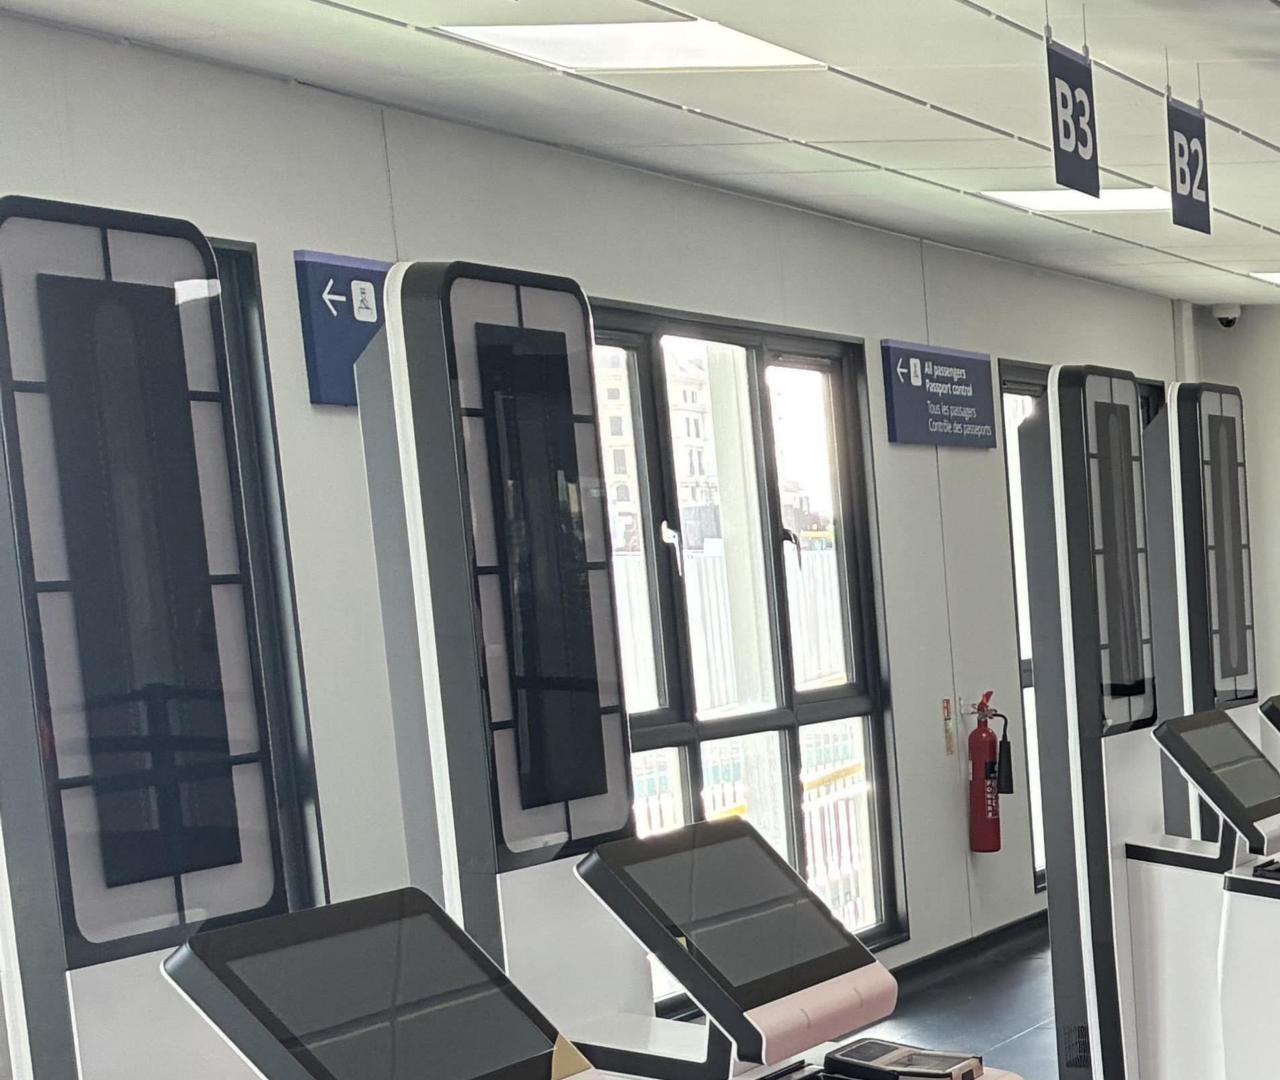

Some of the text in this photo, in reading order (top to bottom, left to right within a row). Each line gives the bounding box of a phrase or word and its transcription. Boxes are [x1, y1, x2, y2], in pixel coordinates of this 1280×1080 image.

[1054, 76, 1093, 161] B3
[1173, 129, 1207, 202] B2
[924, 361, 967, 381] All passengers
[925, 379, 973, 397] Passport control
